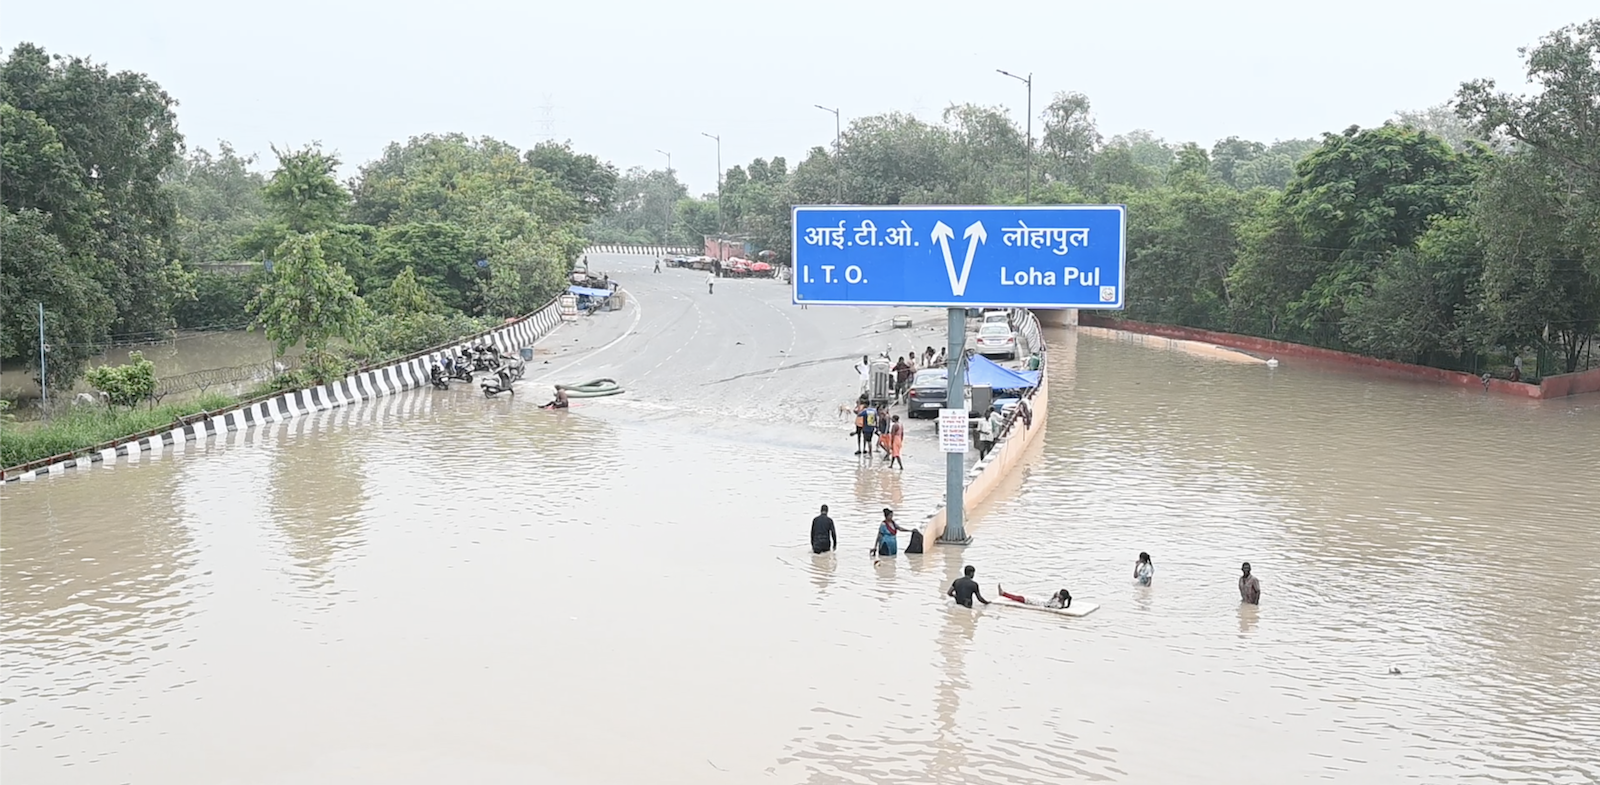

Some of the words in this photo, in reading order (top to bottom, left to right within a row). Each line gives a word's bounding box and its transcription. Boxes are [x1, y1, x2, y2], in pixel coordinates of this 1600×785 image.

[804, 219, 919, 250] आई.टी.ओ.
[1001, 219, 1090, 256] लोहापुल
[1000, 266, 1056, 286] Loha
[1064, 267, 1100, 286] Pul
